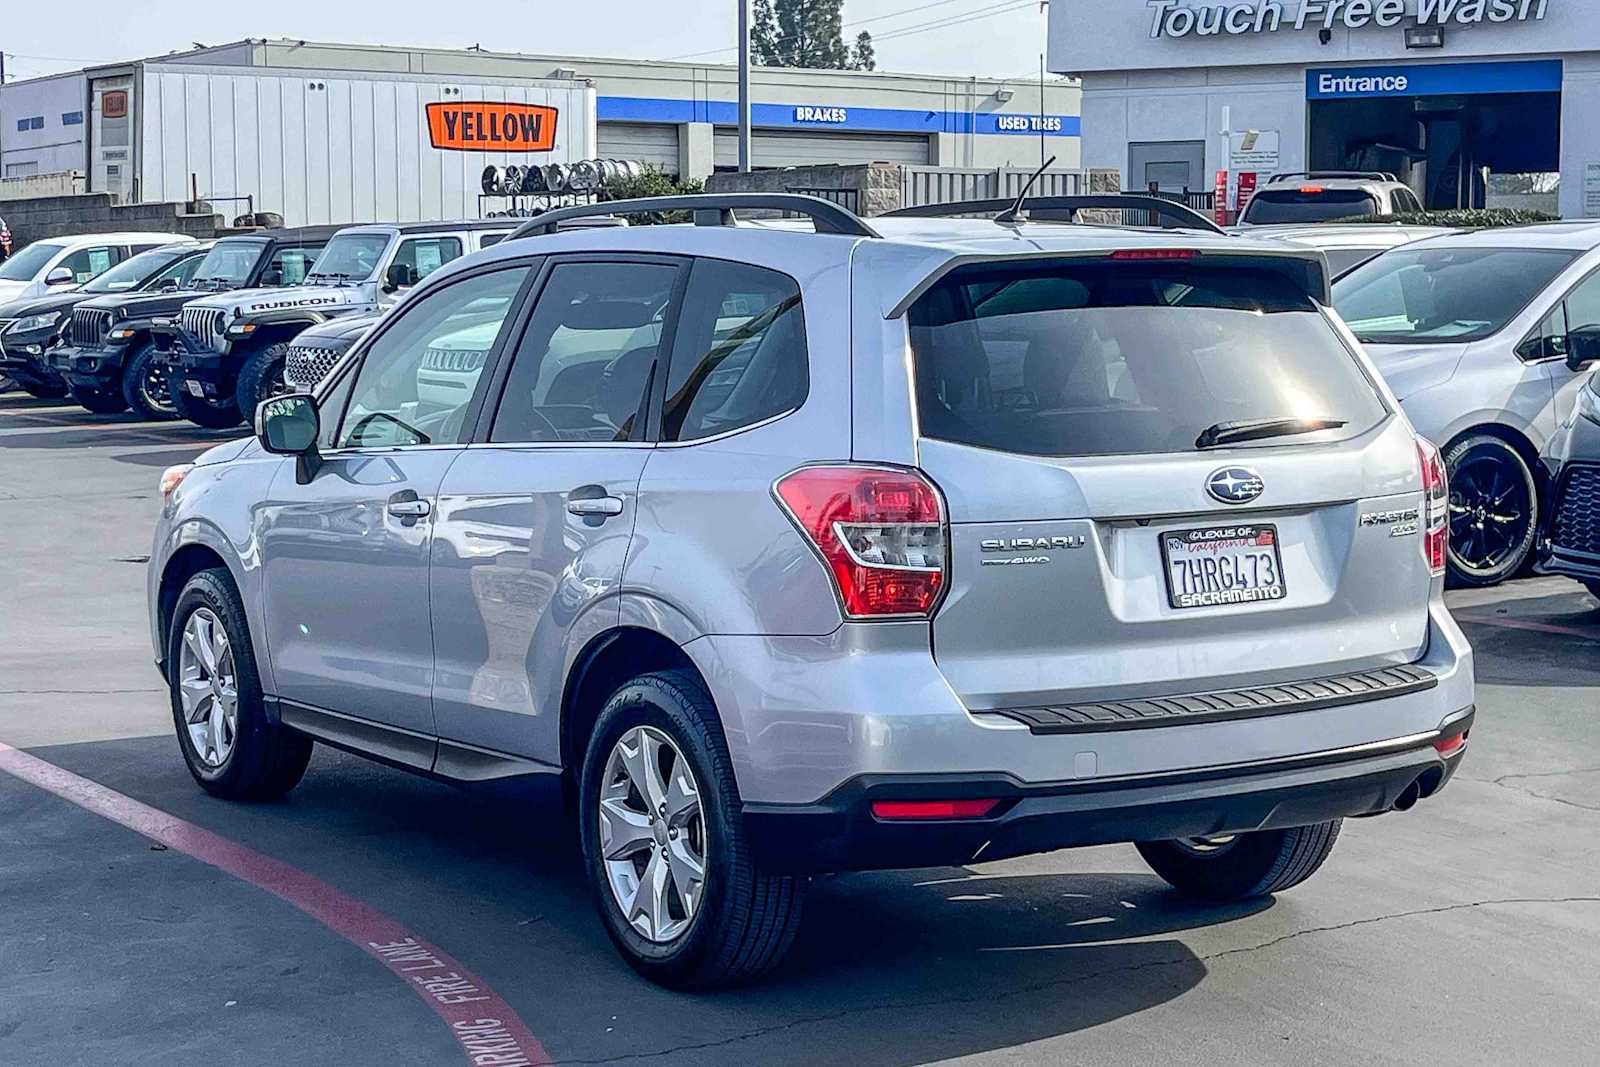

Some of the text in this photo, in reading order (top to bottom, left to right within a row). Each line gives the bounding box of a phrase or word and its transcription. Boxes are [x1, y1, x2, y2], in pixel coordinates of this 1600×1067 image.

[1148, 0, 1283, 37] Touch
[1294, 0, 1404, 30] Free
[1319, 73, 1408, 93] Entrance
[796, 106, 847, 122] BRAKES
[998, 116, 1062, 131] USED TIRES
[443, 111, 542, 142] YELLOW
[251, 297, 337, 310] RUBICON
[980, 535, 1085, 552] SUBARU
[1199, 528, 1236, 540] LEXUS
[1237, 527, 1253, 536] OF
[1173, 553, 1276, 594] 7HRG473
[1180, 586, 1281, 607] SACRAMENTO
[368, 937, 446, 972] LANE
[413, 972, 491, 1005] FIRE
